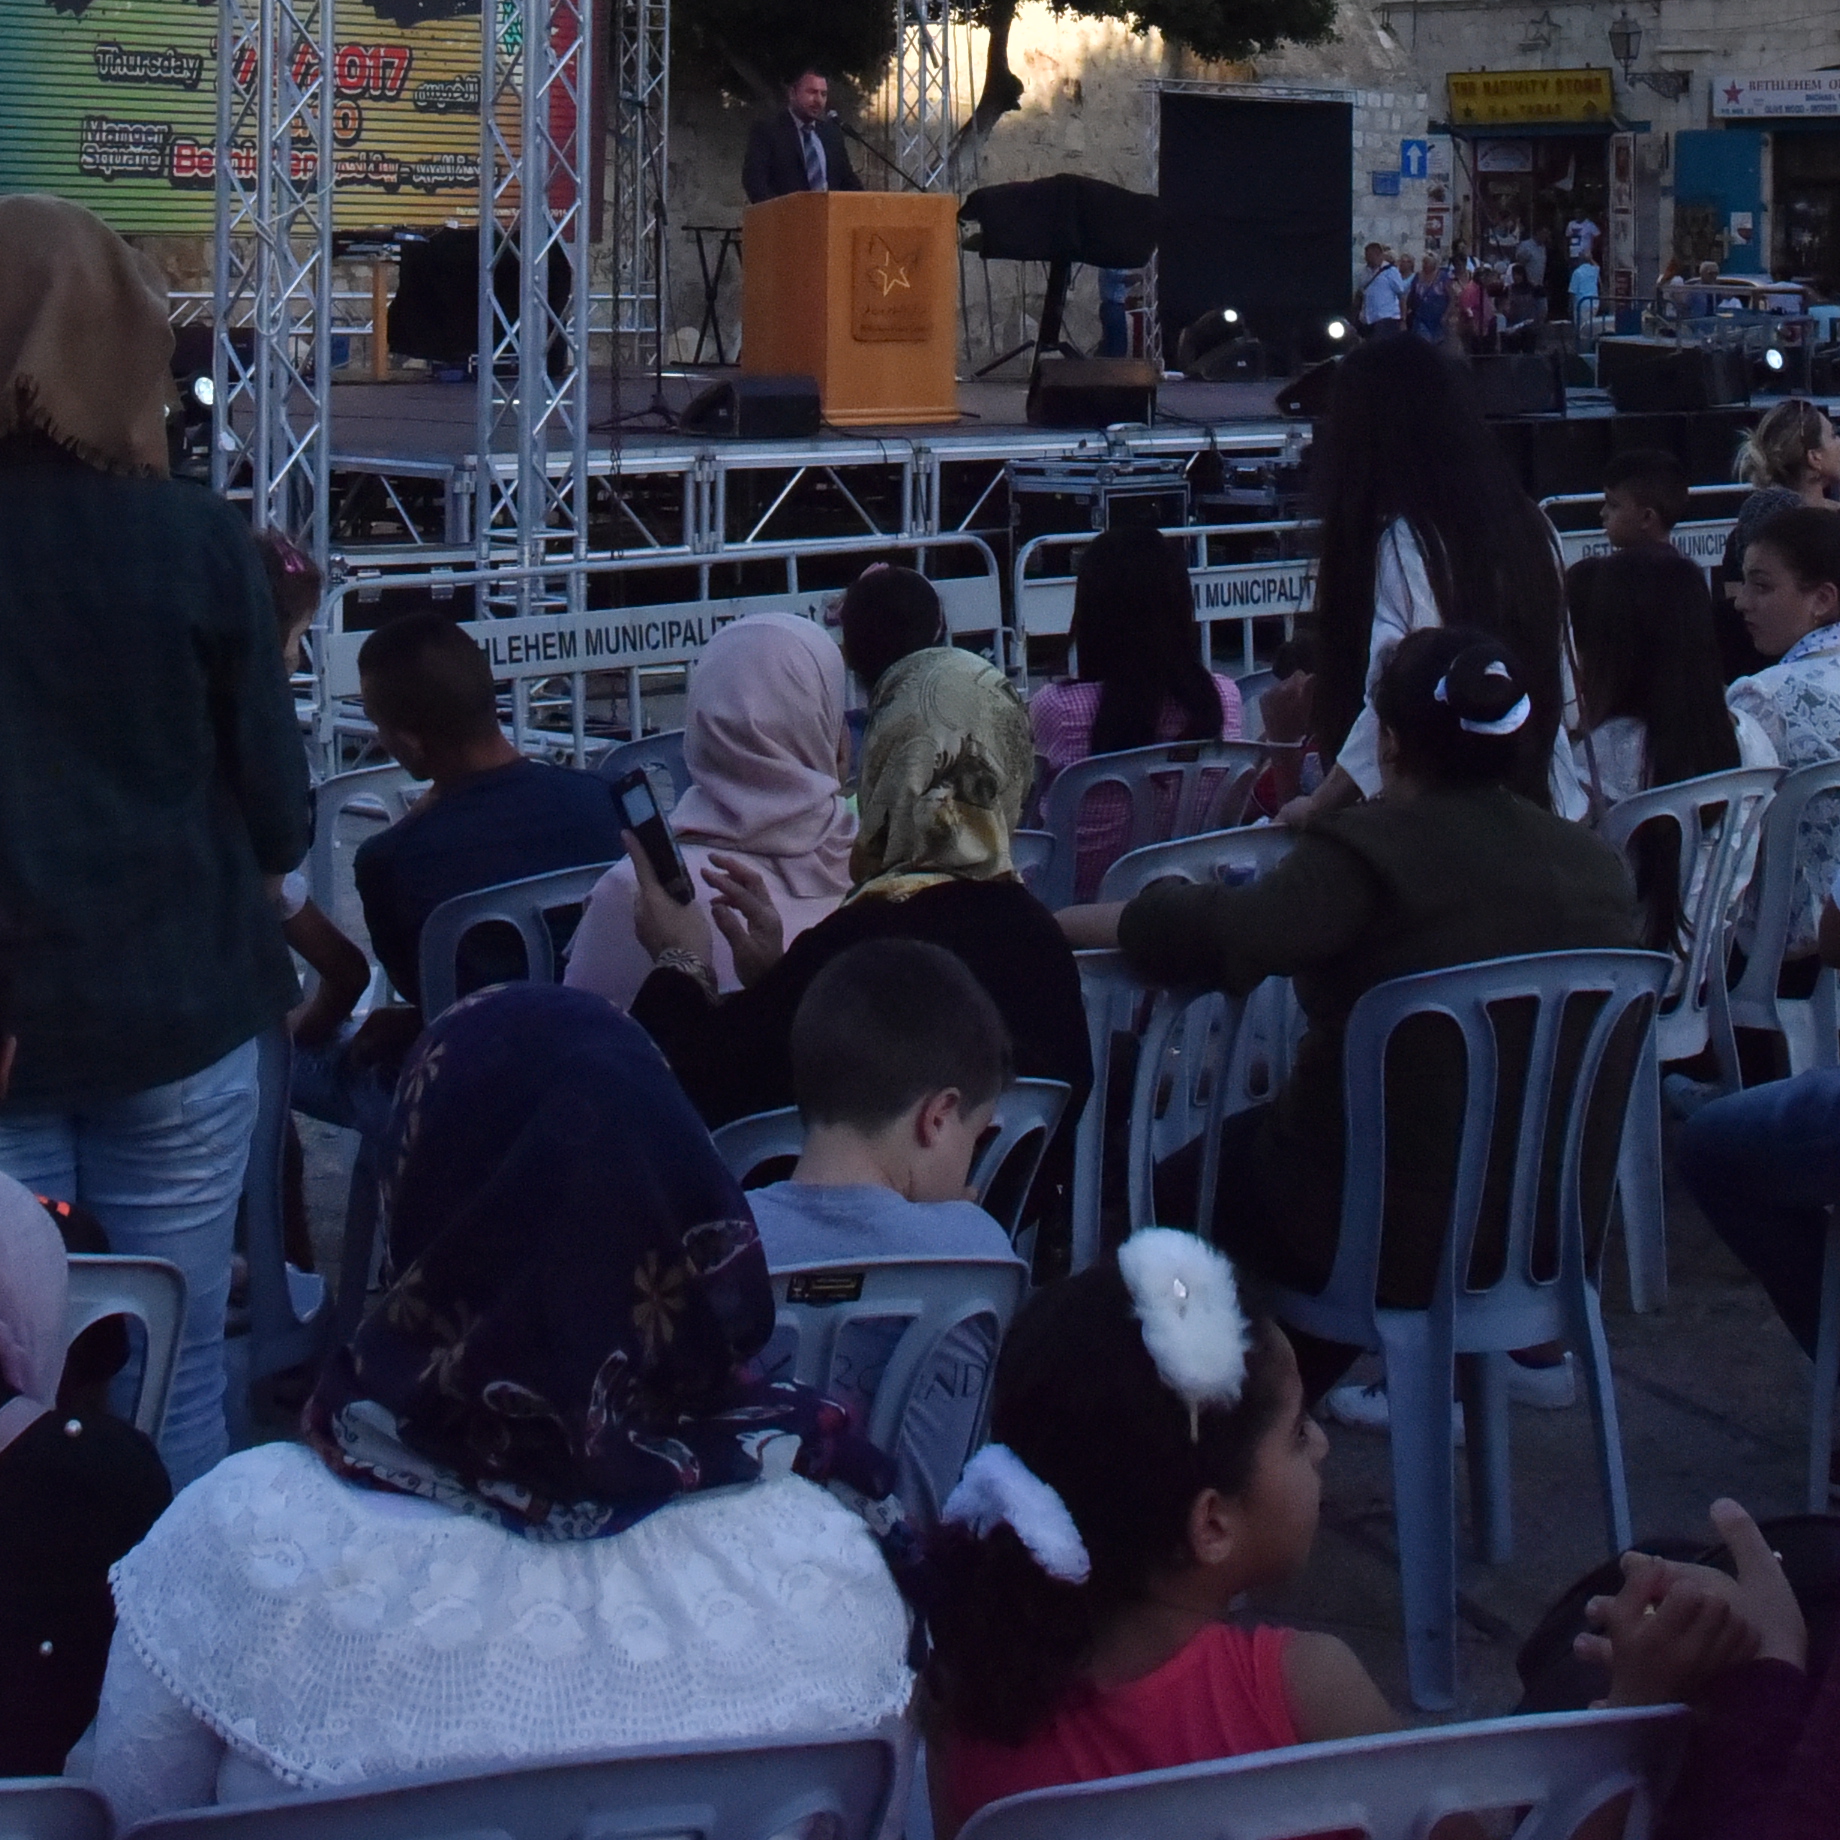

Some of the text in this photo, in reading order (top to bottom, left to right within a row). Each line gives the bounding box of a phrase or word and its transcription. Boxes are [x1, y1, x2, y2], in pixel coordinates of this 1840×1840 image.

[95, 45, 201, 82] Thursday
[414, 76, 478, 108] الخميس
[1452, 81, 1476, 95] THE
[1483, 79, 1549, 96] NATIVITY
[1748, 79, 1822, 91] BETHLEHEM
[82, 119, 169, 144] Manger
[80, 142, 162, 175] Square
[1206, 575, 1314, 608] MUNICIPALIT
